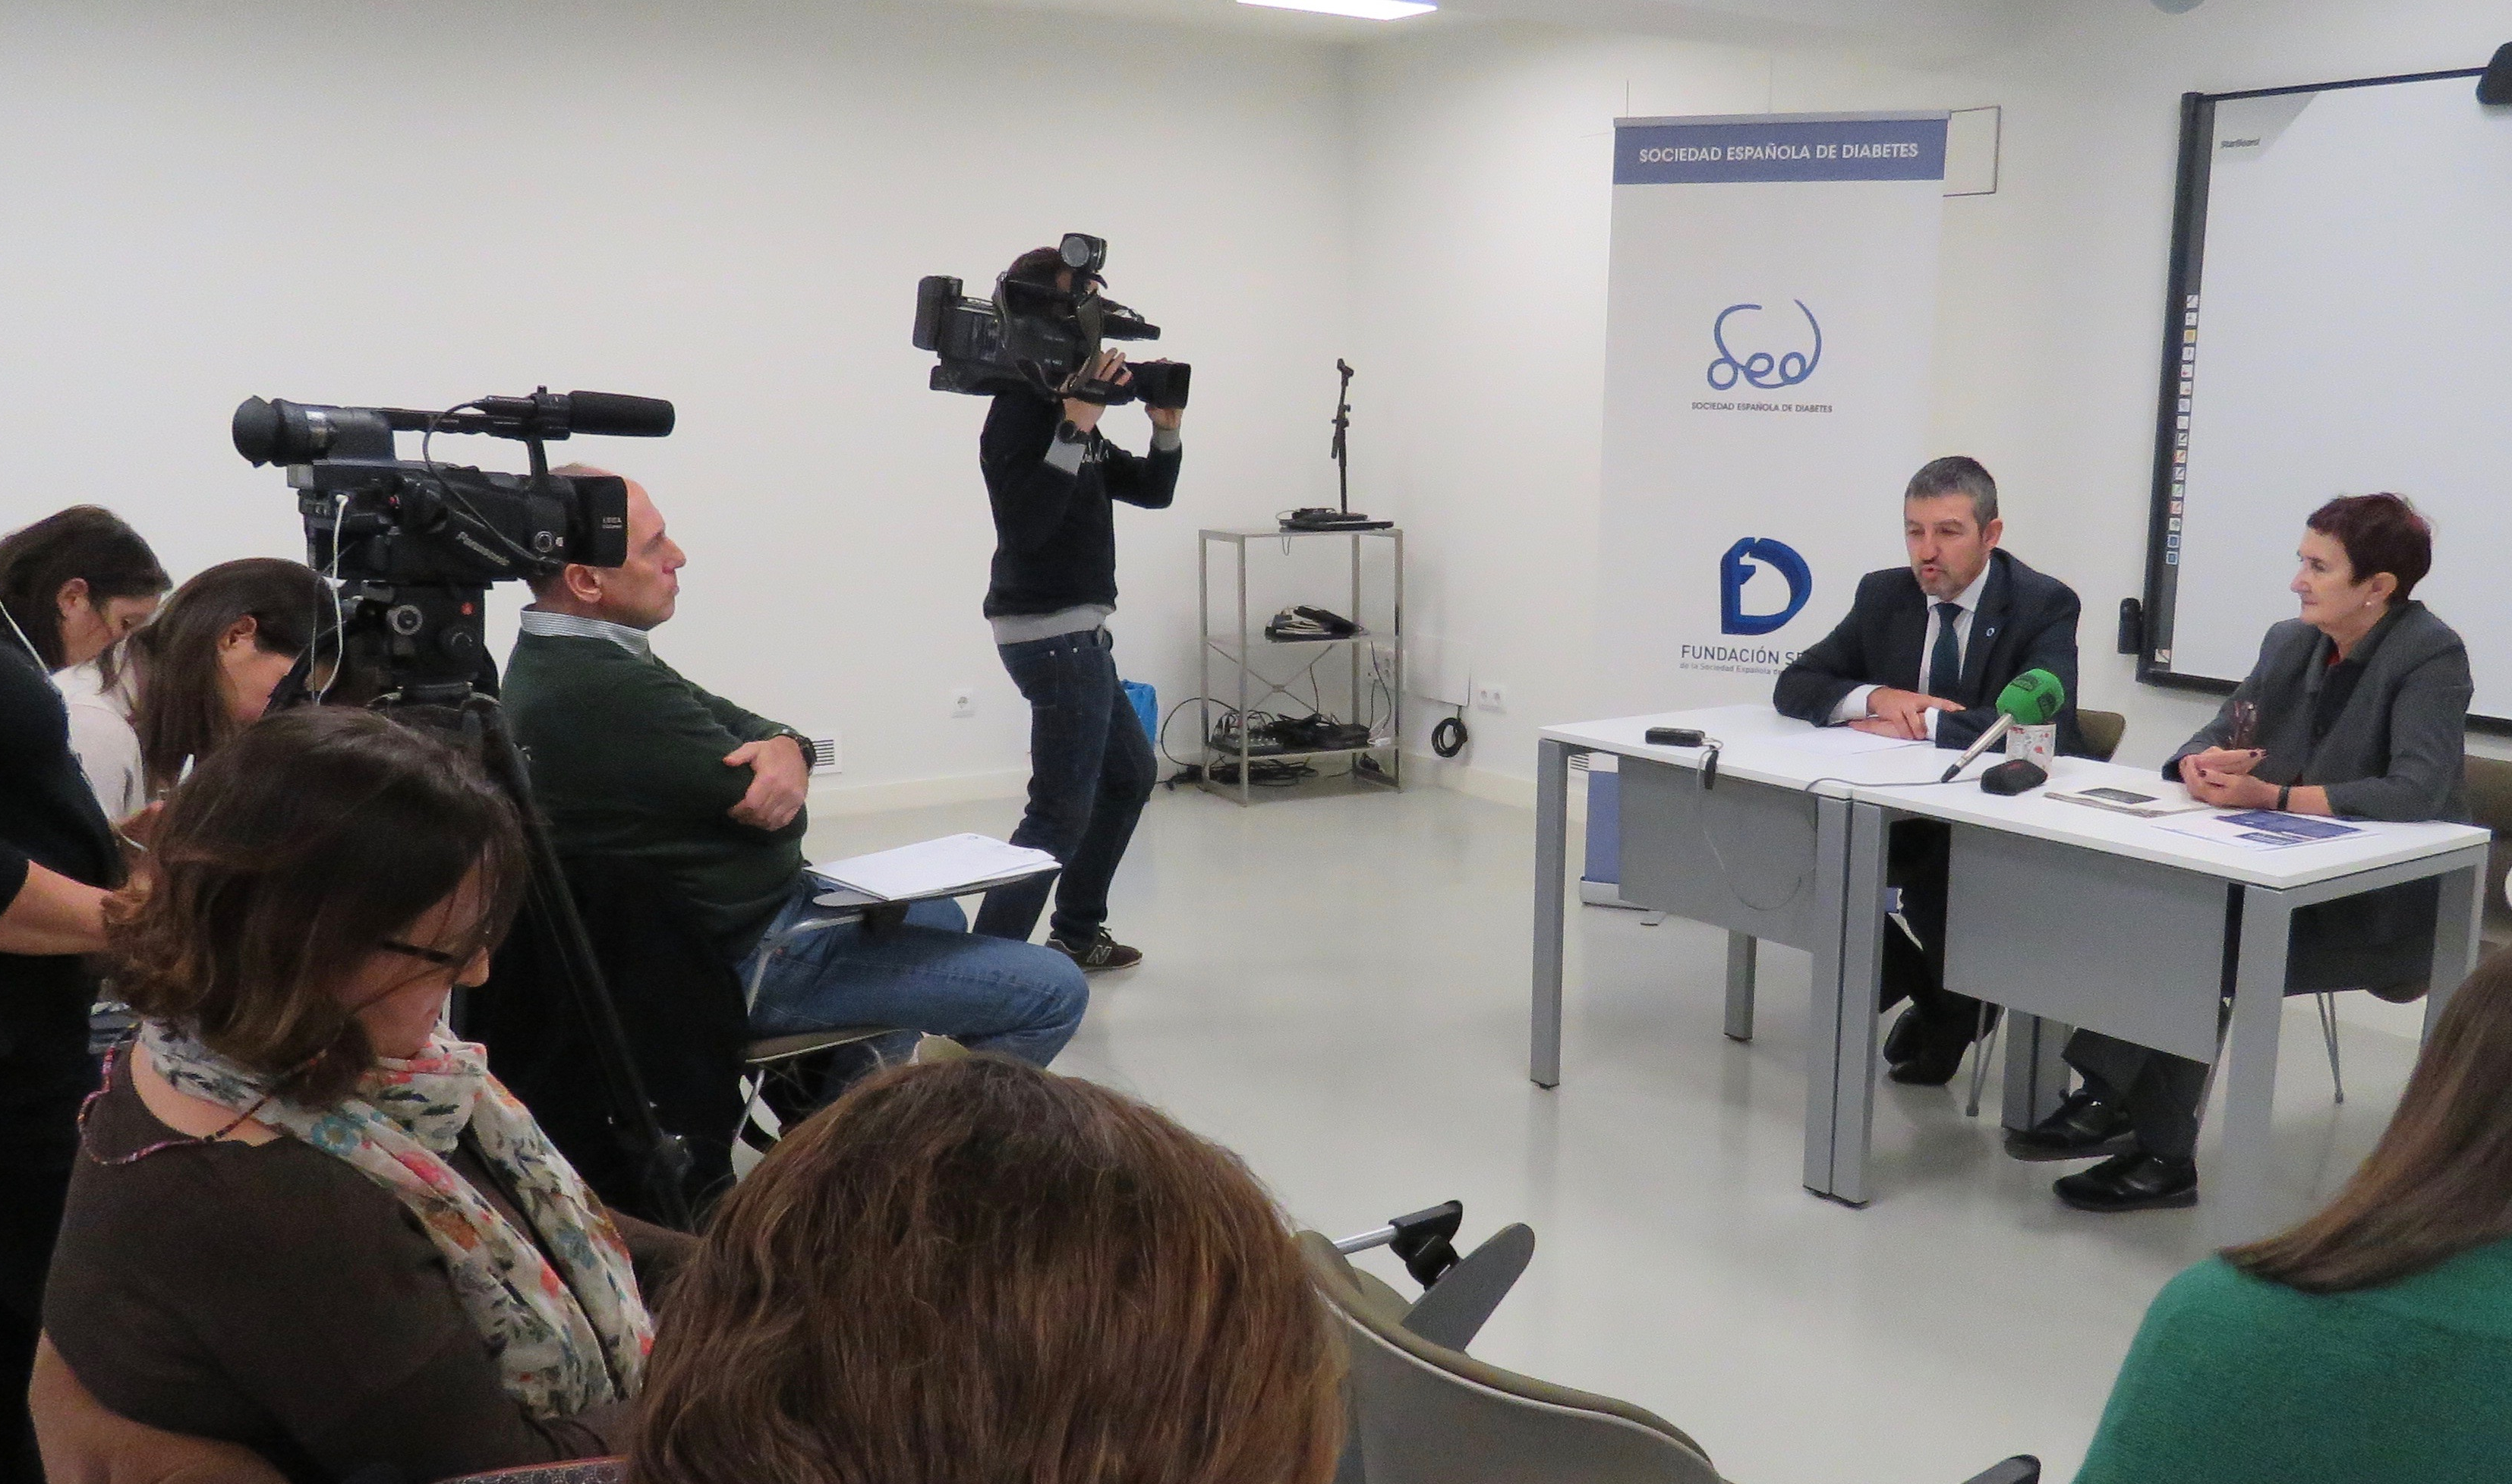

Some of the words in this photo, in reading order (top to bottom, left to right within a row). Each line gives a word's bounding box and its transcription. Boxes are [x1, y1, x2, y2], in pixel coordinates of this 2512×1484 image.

[1639, 147, 1722, 163] SOCIEDAD
[1726, 143, 1811, 161] ESPAÑOLA
[1816, 144, 1837, 159] DE
[1842, 143, 1919, 159] DIABETES
[1691, 402, 1735, 411] SOCIEDAD
[1737, 402, 1779, 412] ESPAÑOLA
[1782, 404, 1793, 412] DE
[1795, 404, 1833, 414] DIABETES
[1681, 644, 1779, 665] FUNDACIÓN
